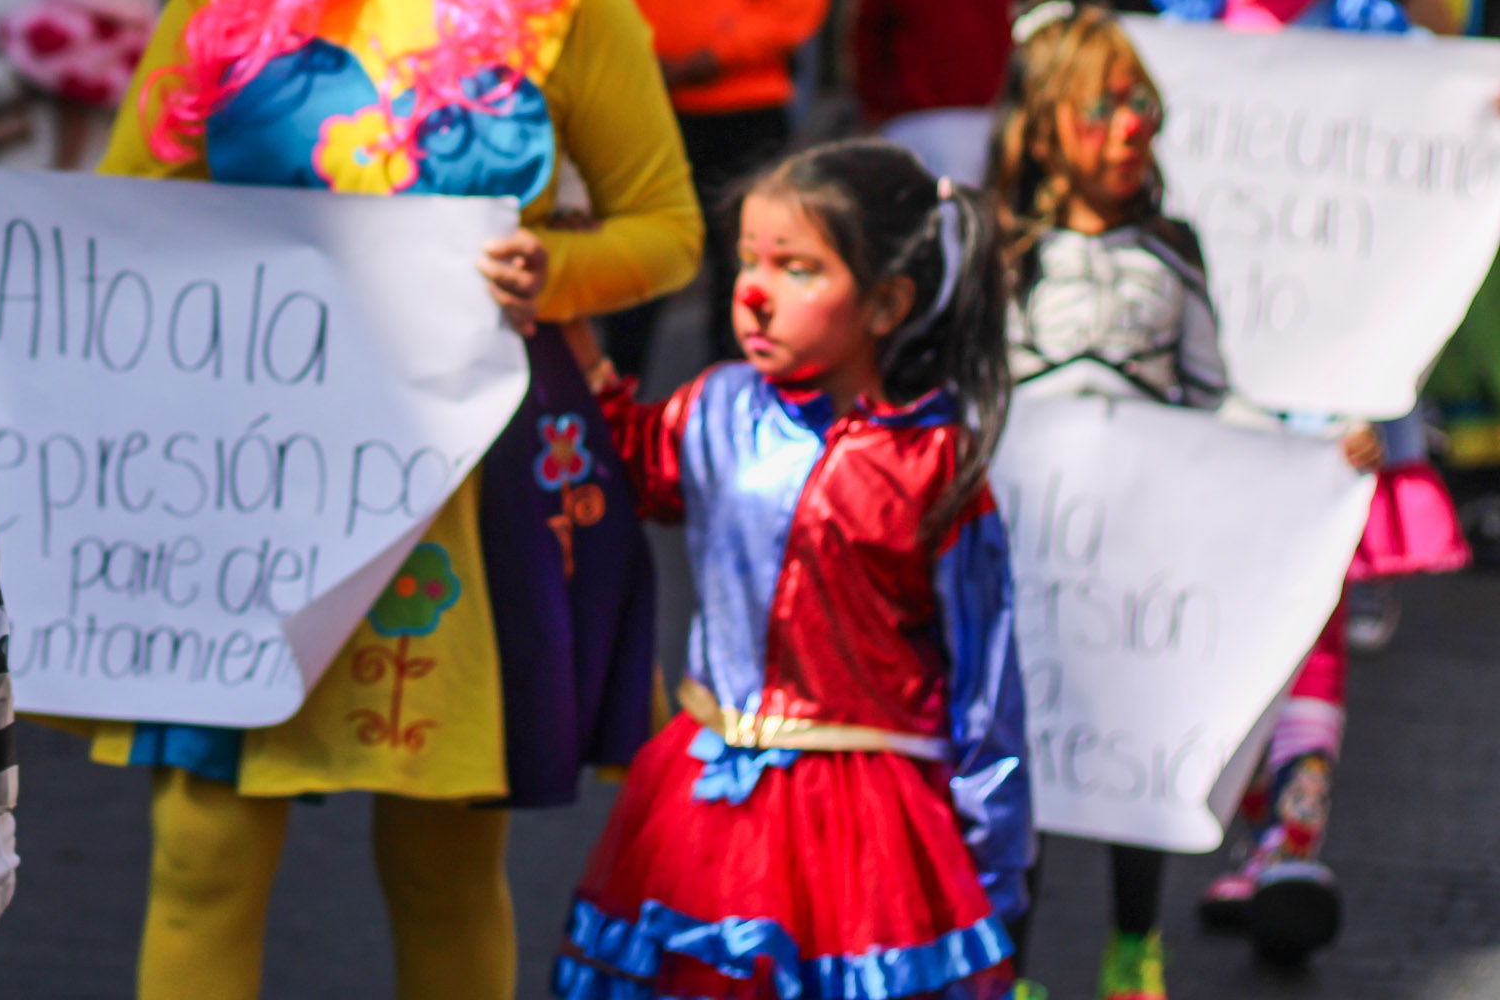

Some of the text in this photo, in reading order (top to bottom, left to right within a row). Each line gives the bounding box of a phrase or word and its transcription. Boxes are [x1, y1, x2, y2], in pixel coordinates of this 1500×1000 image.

[168, 278, 224, 380] a
[245, 262, 328, 386] la
[70, 535, 203, 618] parte
[7, 611, 298, 691] untamien
